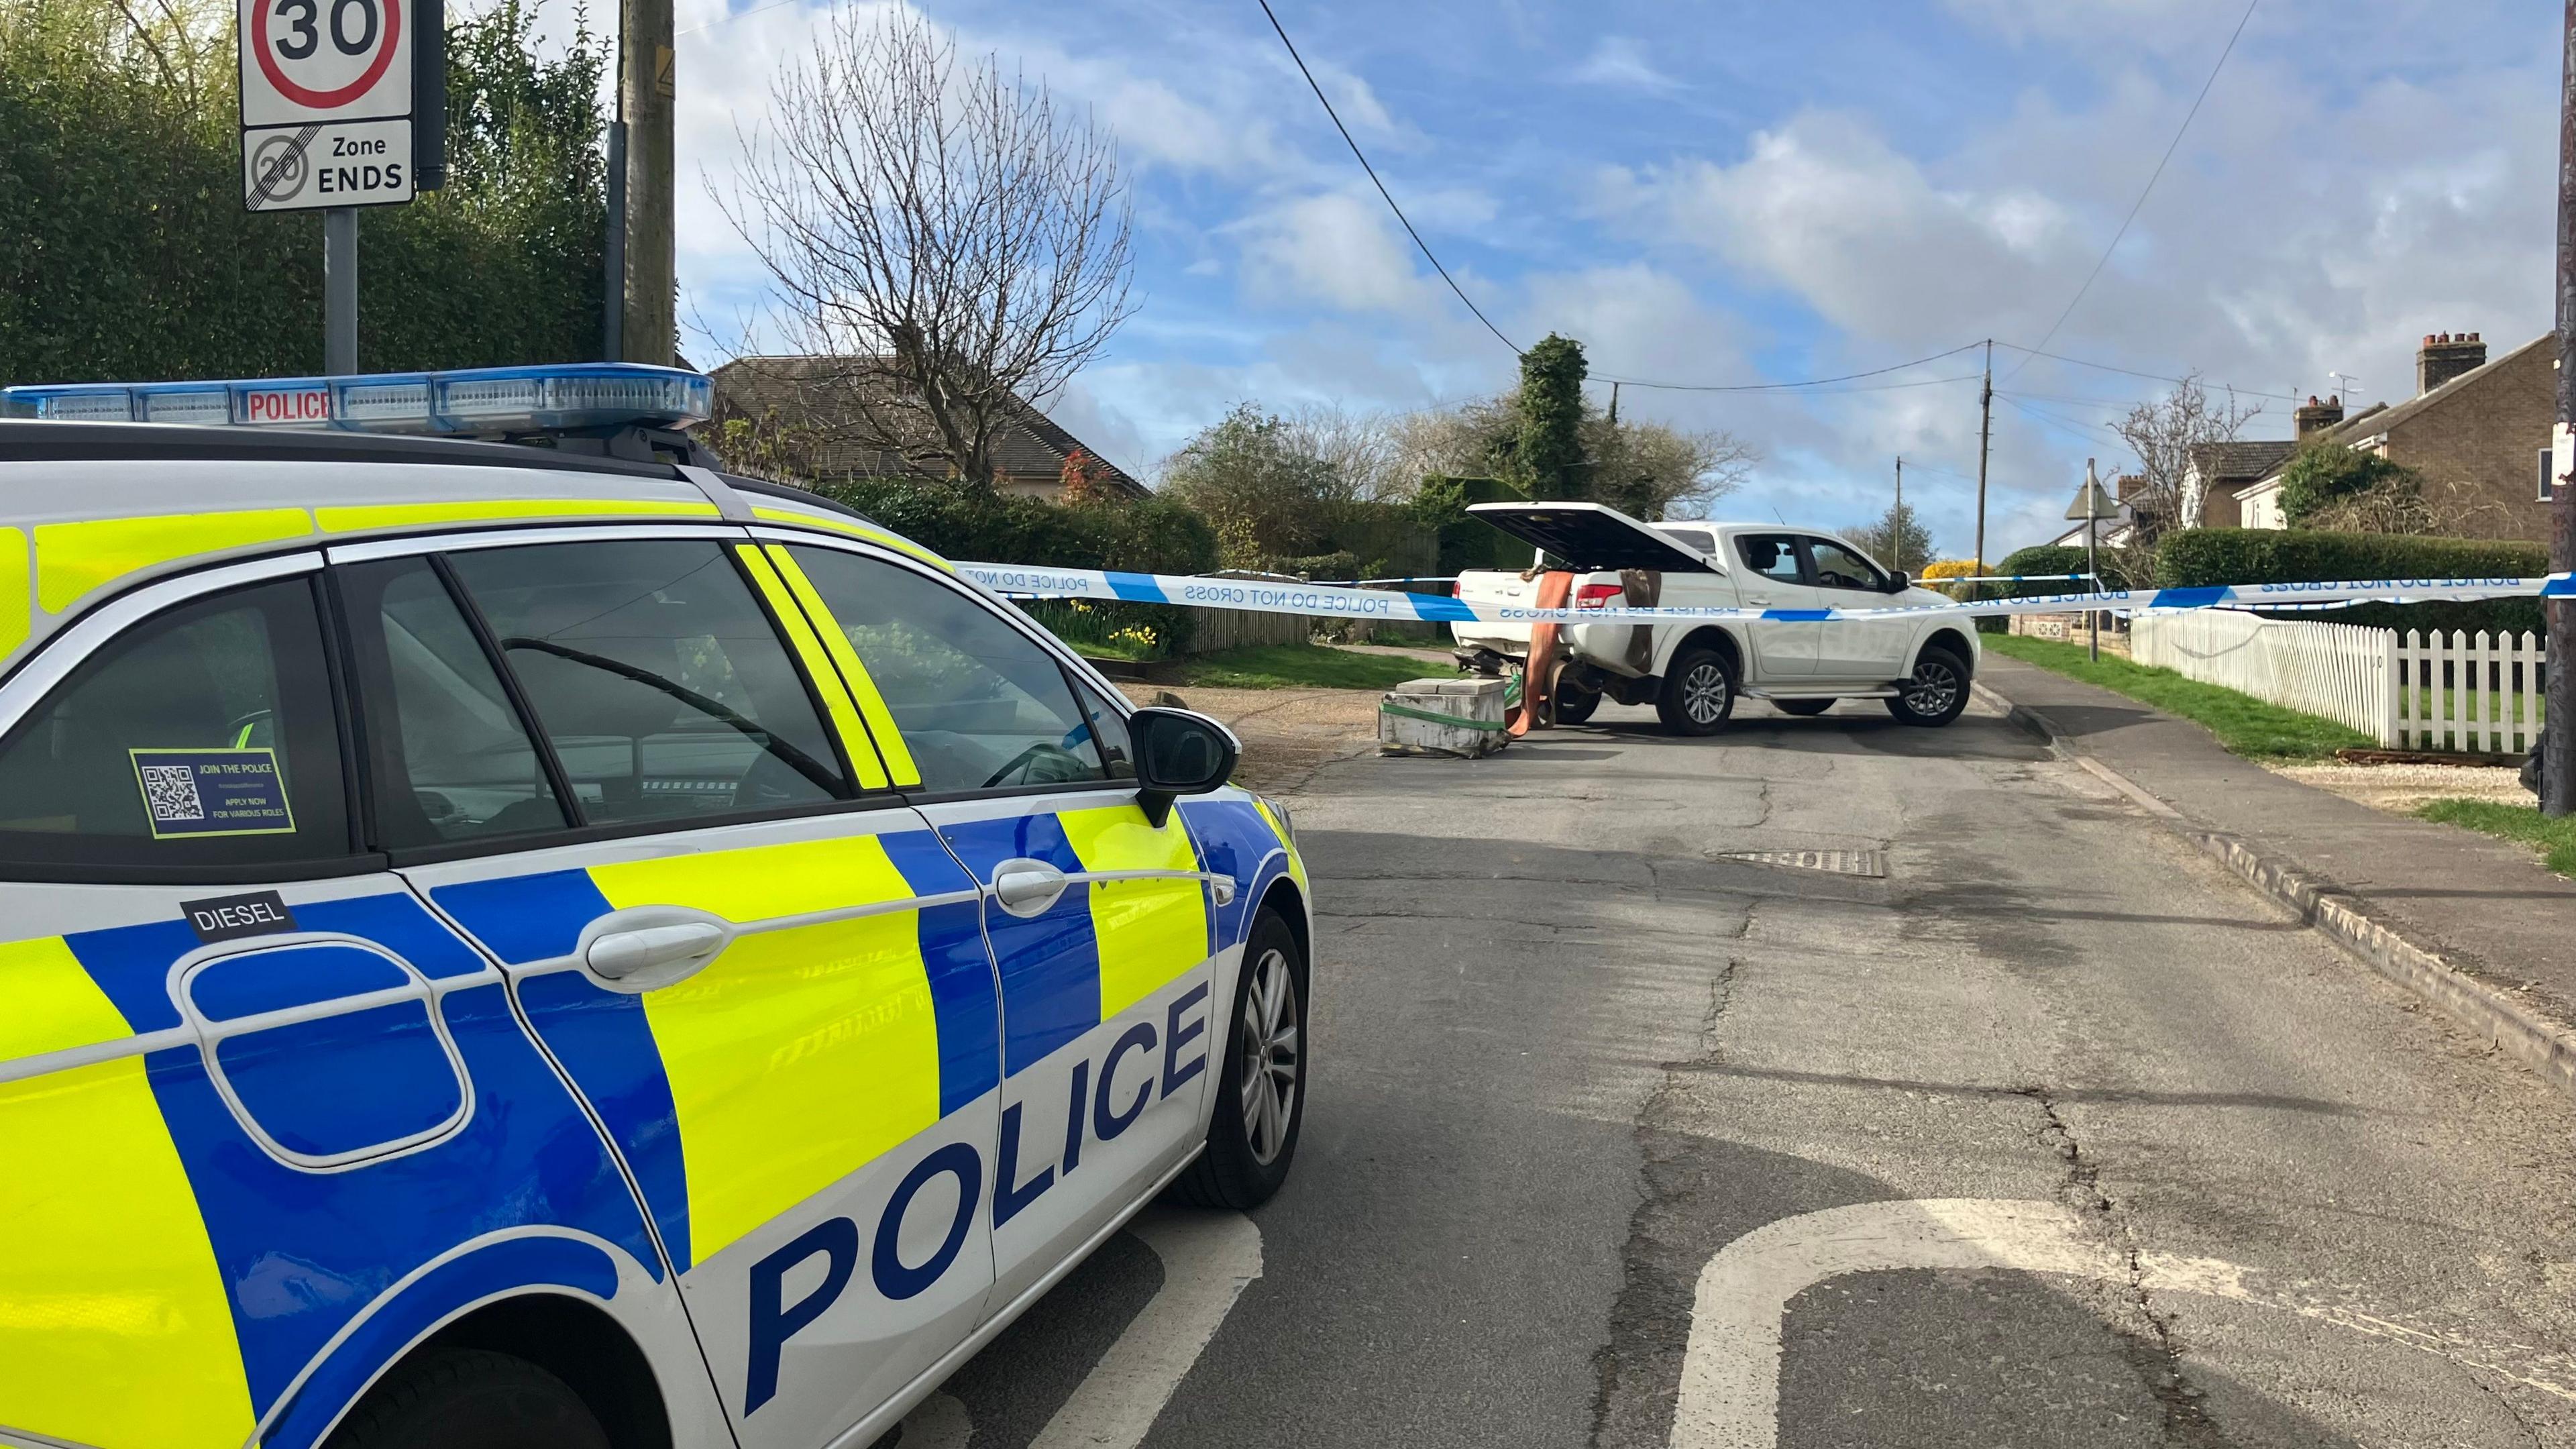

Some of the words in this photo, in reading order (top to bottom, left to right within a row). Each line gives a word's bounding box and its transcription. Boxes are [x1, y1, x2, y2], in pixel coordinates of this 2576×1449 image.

[275, 0, 377, 60] 30
[333, 137, 386, 157] Zone
[260, 156, 299, 183] 20
[319, 164, 402, 193] ENDS
[250, 392, 329, 421] POLICE
[200, 765, 220, 774] JOIN
[221, 764, 240, 773] THE
[241, 763, 272, 773] POLICE
[213, 810, 229, 818] FOR
[229, 809, 262, 818] VARIOUS
[262, 808, 284, 816] ROLES
[225, 798, 248, 806] APPLY
[248, 797, 266, 805] NOW
[194, 902, 284, 931] DIESEL
[744, 979, 1208, 1419] POLICE
